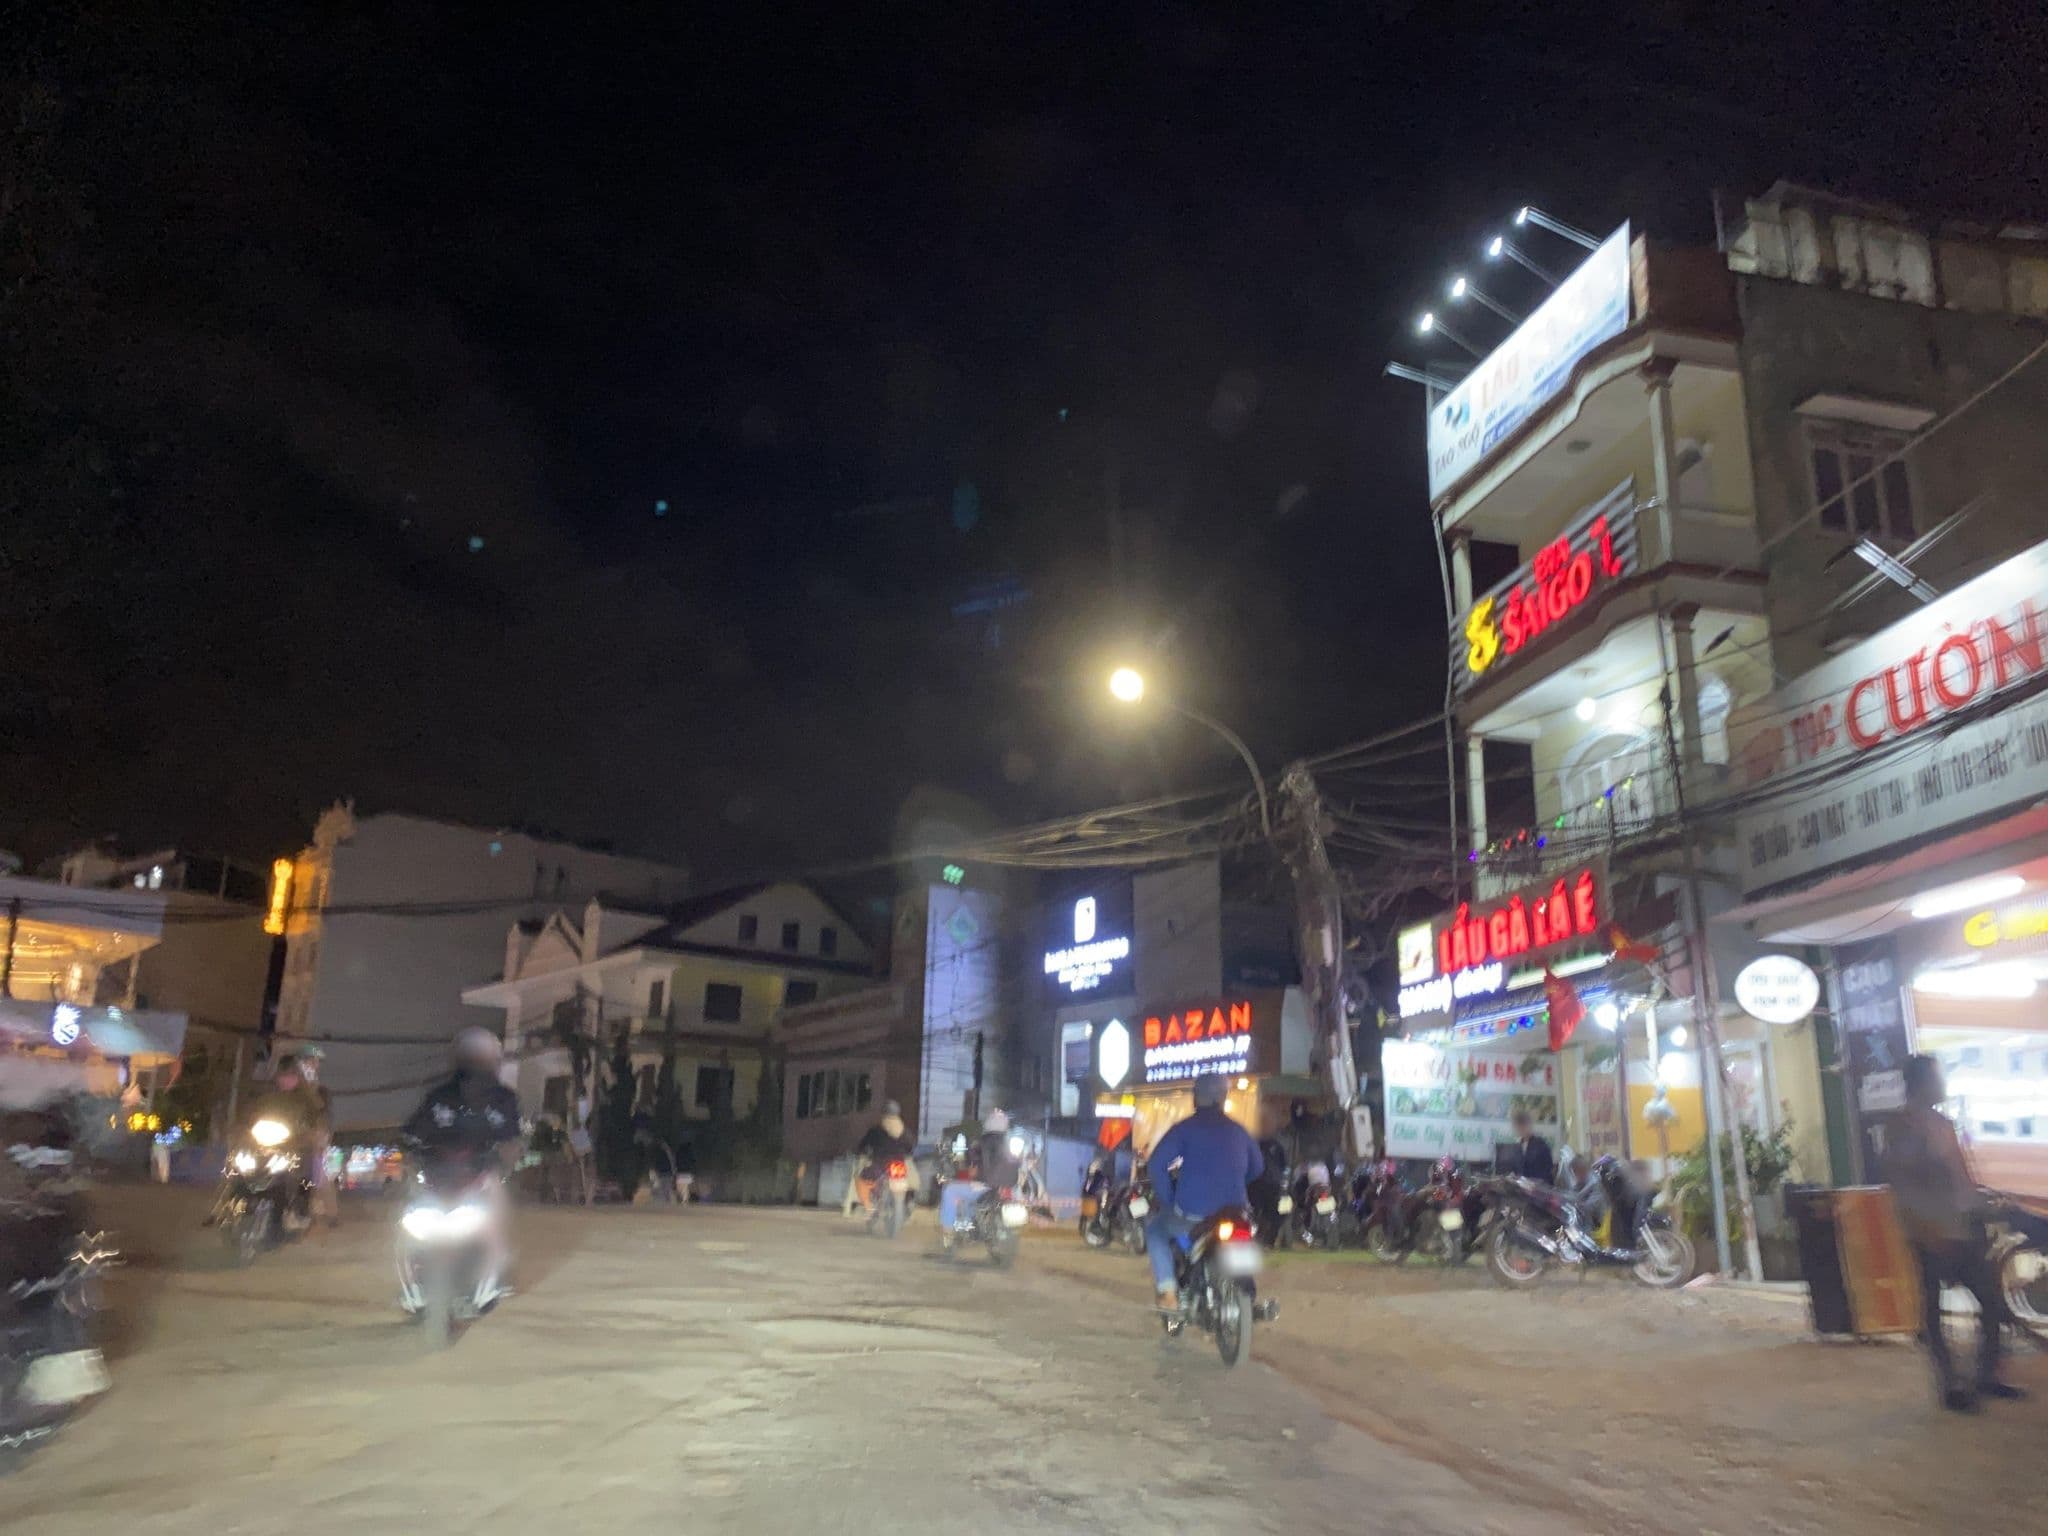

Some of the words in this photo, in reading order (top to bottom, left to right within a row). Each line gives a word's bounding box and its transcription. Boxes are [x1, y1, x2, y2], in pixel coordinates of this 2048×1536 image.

[1489, 895, 1530, 959] GÀ
[1532, 877, 1572, 948] LÁ
[1574, 868, 1597, 935] É
[1143, 1001, 1253, 1049] BAZAN
